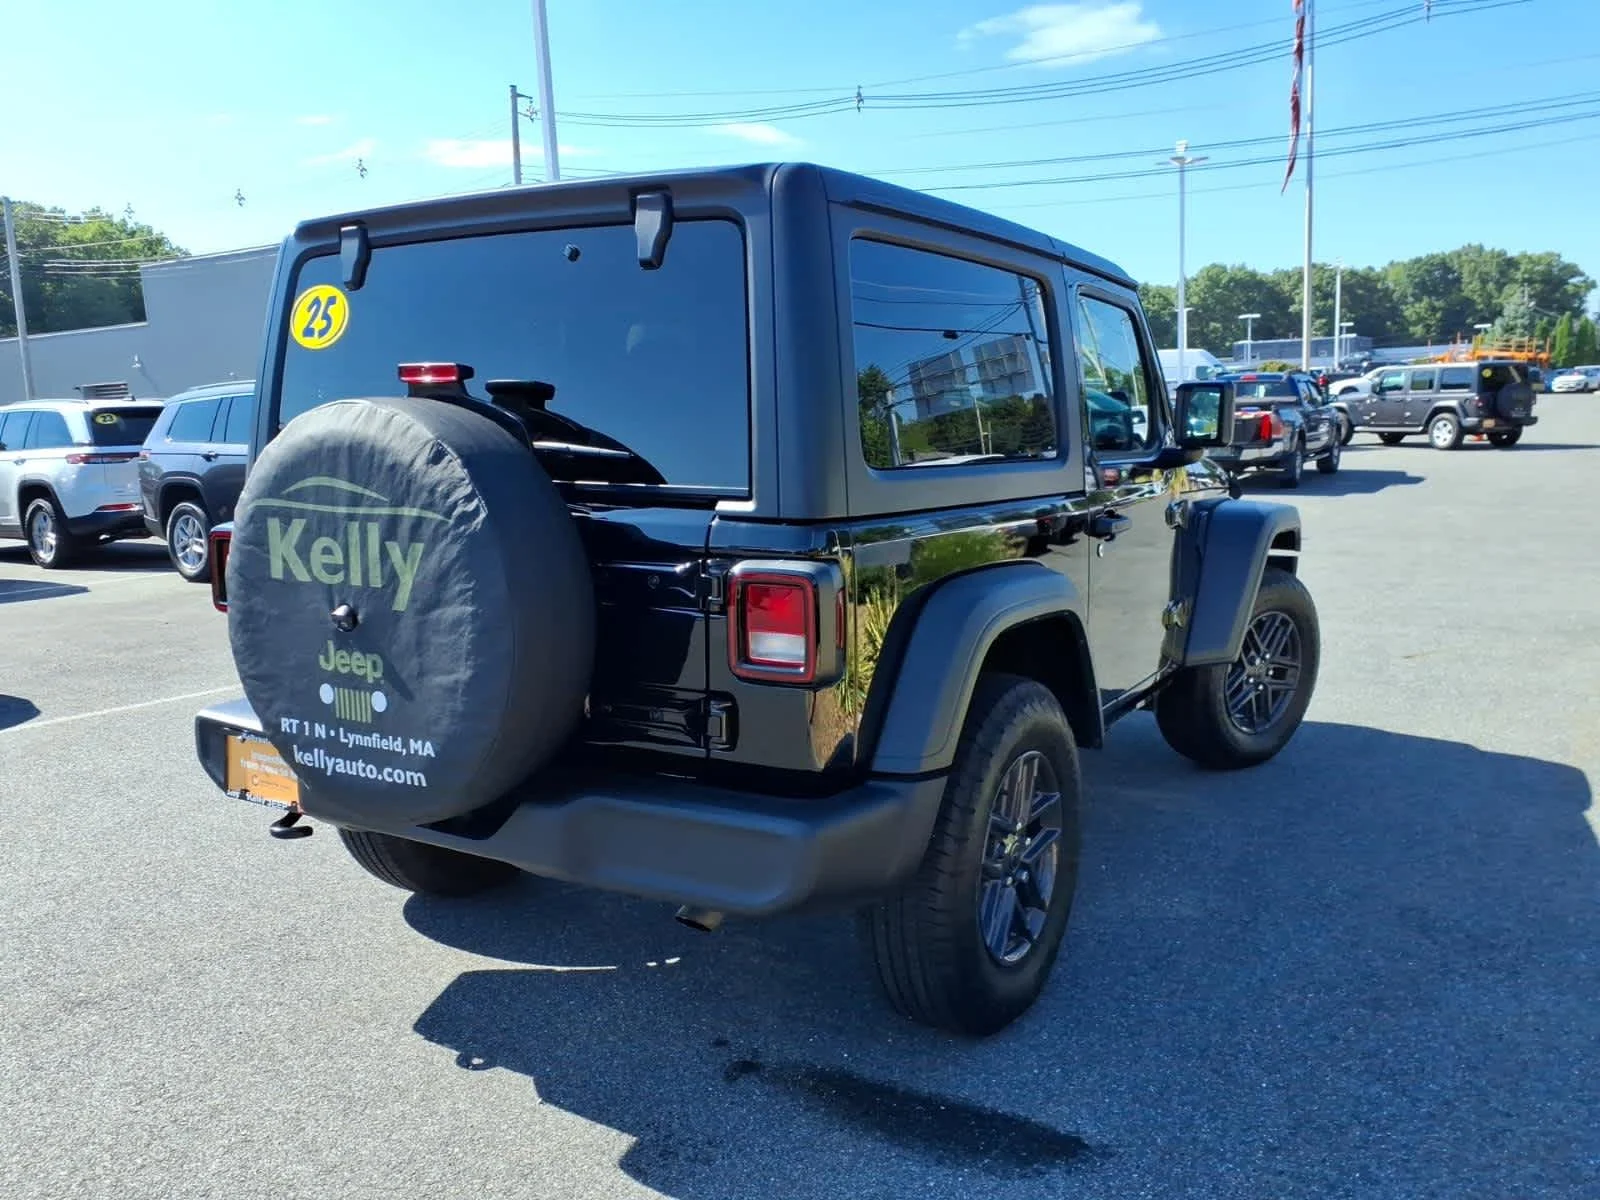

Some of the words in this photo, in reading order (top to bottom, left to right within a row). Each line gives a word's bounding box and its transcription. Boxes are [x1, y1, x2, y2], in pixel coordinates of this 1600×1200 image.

[302, 296, 338, 339] 25
[267, 517, 424, 612] Kelly
[319, 640, 383, 684] Jeep
[281, 717, 298, 735] RT
[303, 722, 310, 736] 1
[315, 723, 326, 740] N
[340, 728, 406, 755] Lynnfield,
[409, 739, 436, 758] MA
[294, 745, 427, 787] kellyauto.com
